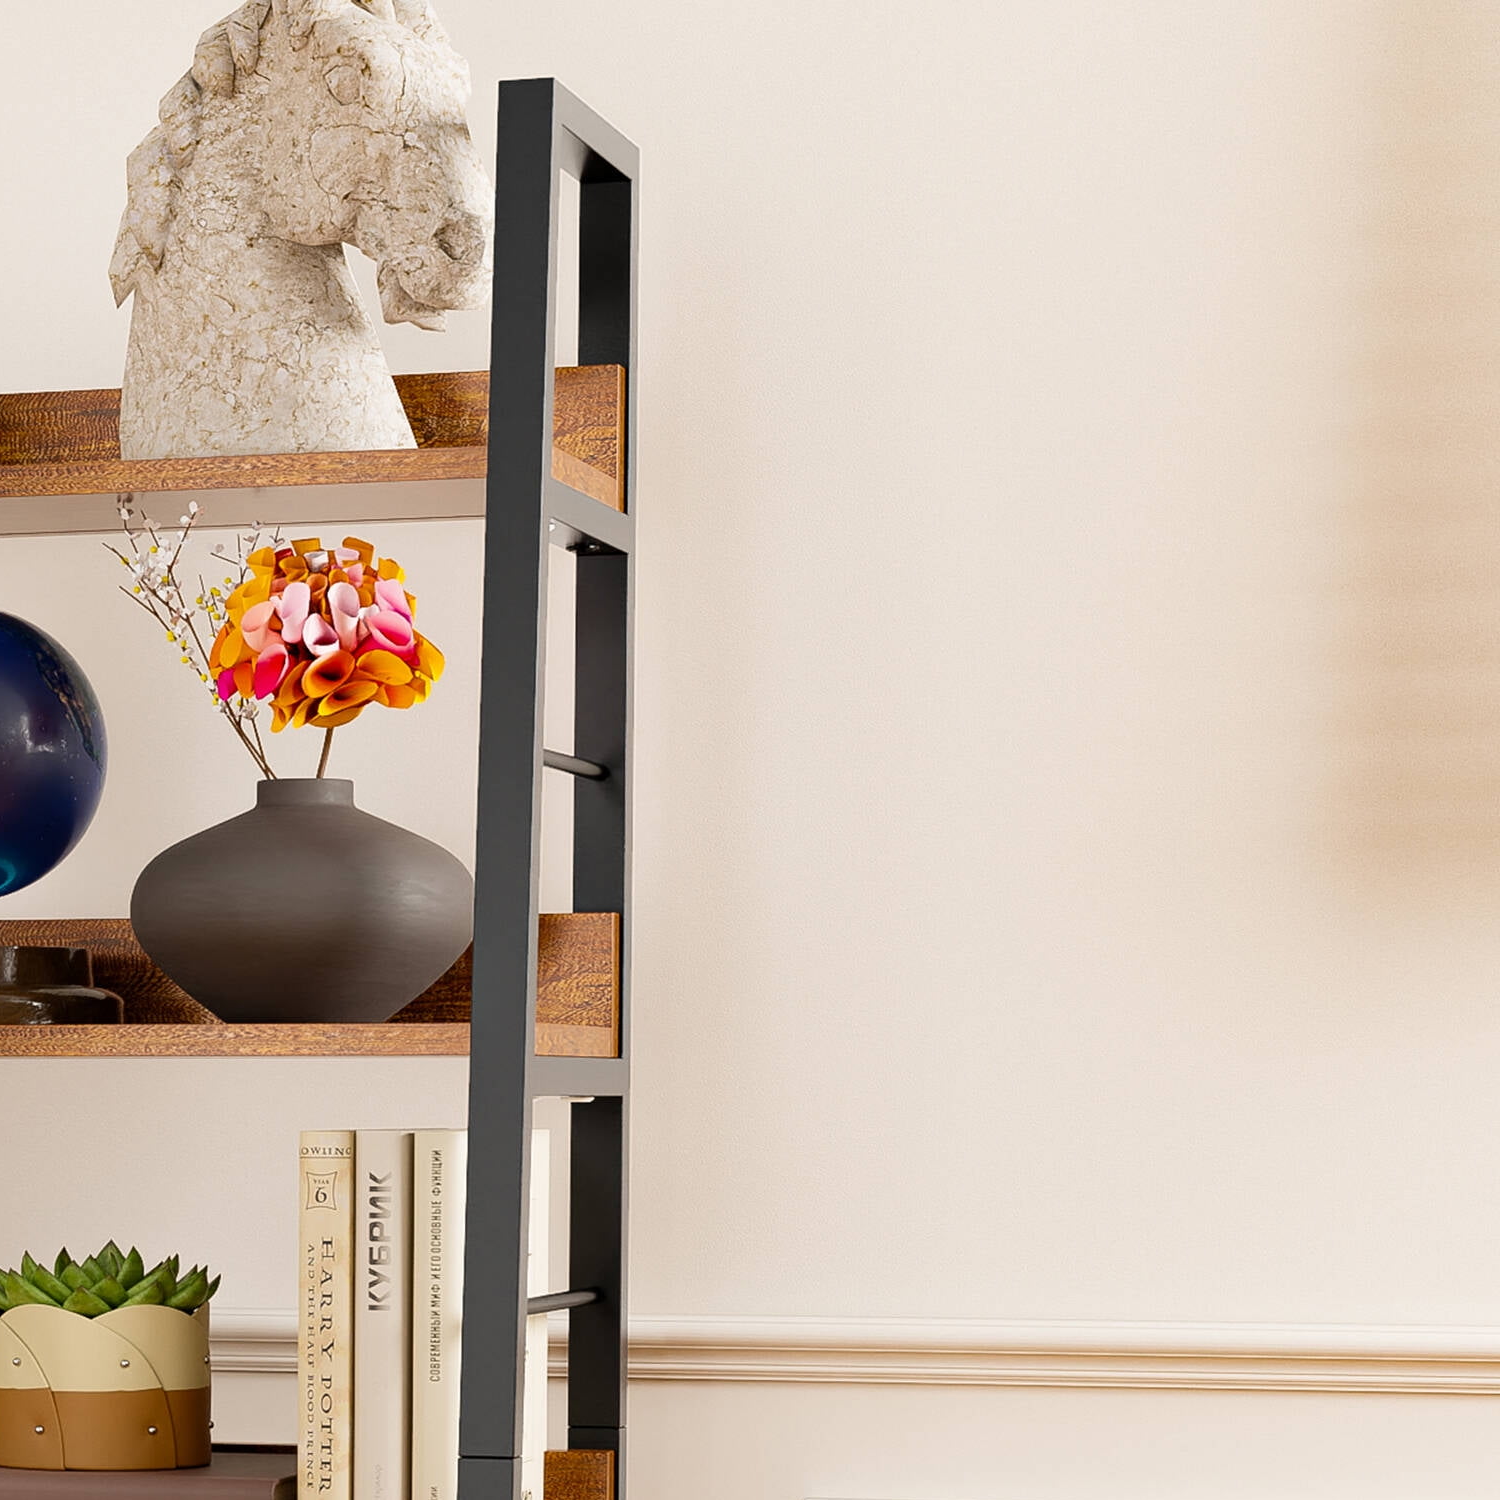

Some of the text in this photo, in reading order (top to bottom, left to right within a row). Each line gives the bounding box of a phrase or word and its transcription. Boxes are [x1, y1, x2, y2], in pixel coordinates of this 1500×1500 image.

[315, 1187, 328, 1204] 6
[368, 1171, 393, 1312] КУБРИК
[431, 1200, 442, 1254] ОСНОВНЫЕ
[430, 1255, 442, 1272] ЕГО
[430, 1284, 442, 1308] МИФ
[306, 1244, 316, 1490] AND THE HALF BLOOD PRINCE
[319, 1236, 336, 1494] HARRY POTTER
